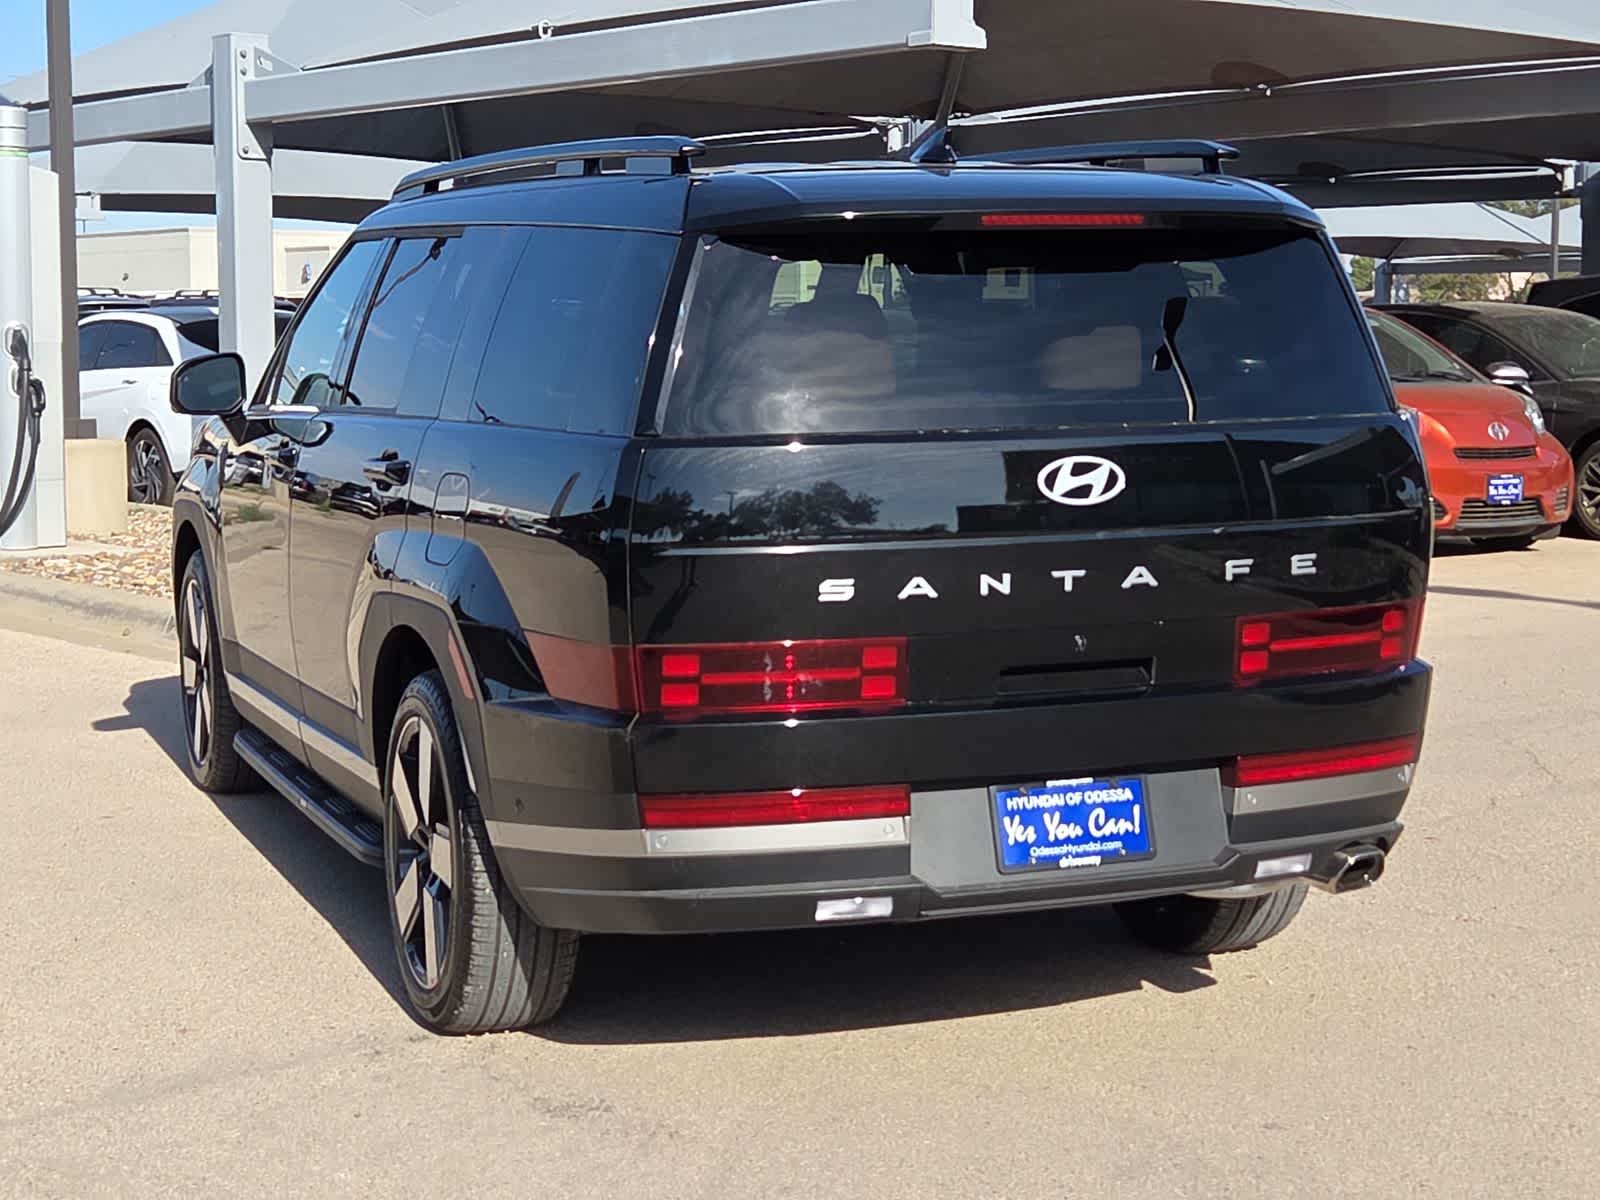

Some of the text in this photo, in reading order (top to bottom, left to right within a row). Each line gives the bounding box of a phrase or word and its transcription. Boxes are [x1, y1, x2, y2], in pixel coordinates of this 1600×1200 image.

[818, 552, 1317, 603] SANTA FE
[1007, 788, 1133, 811] HYUNDAI OF ODESSA
[1003, 804, 1140, 846] Yes You Can!
[1030, 840, 1123, 857] OdessaHyundai.com
